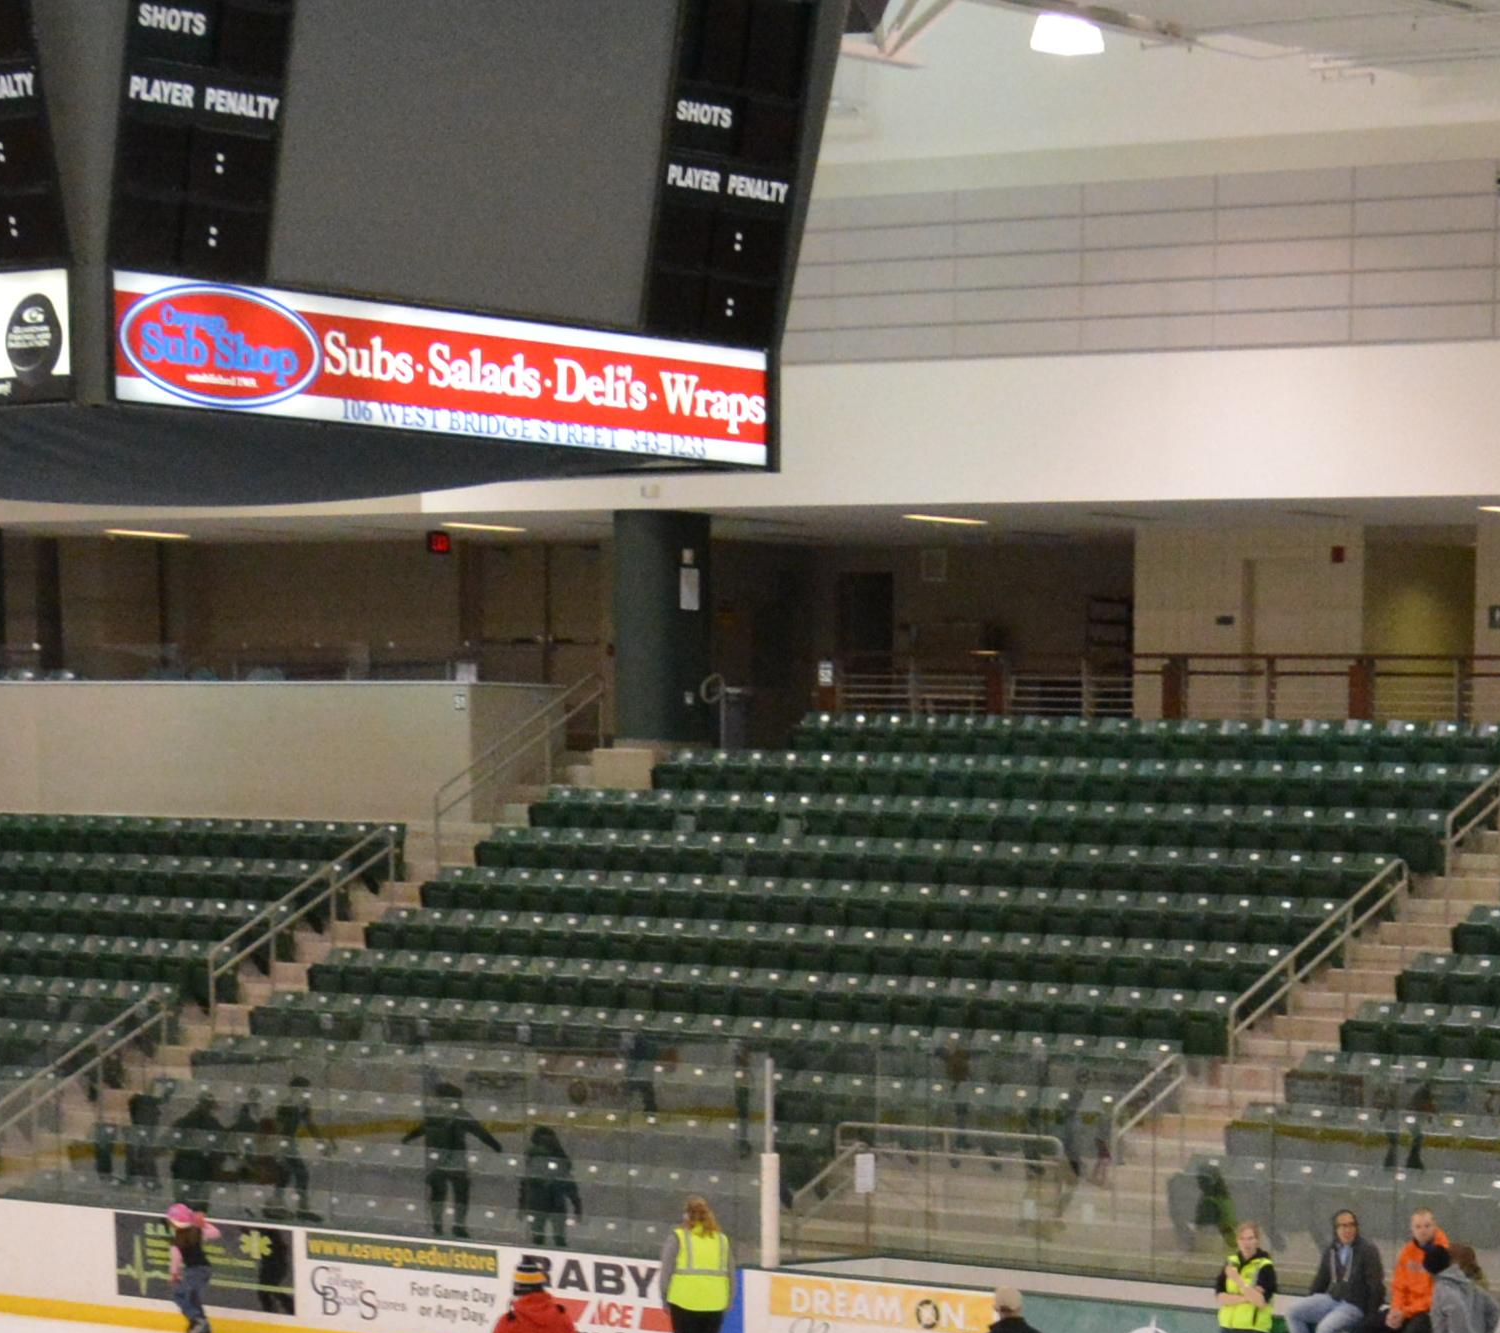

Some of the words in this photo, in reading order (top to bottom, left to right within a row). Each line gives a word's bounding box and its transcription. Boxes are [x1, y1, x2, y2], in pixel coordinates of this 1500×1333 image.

[139, 3, 206, 35] SHOTS
[129, 75, 194, 107] PLAYER
[204, 88, 279, 120] PENALTY
[676, 100, 732, 129] SHOTS
[667, 164, 721, 193] PLAYER
[727, 174, 789, 204] PENALTY
[142, 321, 208, 366] Sub
[215, 332, 299, 386] Shop
[324, 331, 414, 384] Subs
[428, 343, 541, 399] Salads
[554, 358, 647, 411] Deli's
[660, 371, 766, 434] Wraps
[341, 400, 373, 423] 106
[381, 402, 440, 430] WEST
[448, 412, 532, 440] BRIDGE
[539, 421, 619, 449] STREET
[410, 1281, 429, 1298] For
[433, 1284, 469, 1302] Game
[472, 1288, 497, 1307] Day
[790, 1286, 903, 1323] DREAM
[590, 1302, 634, 1329] ACE
